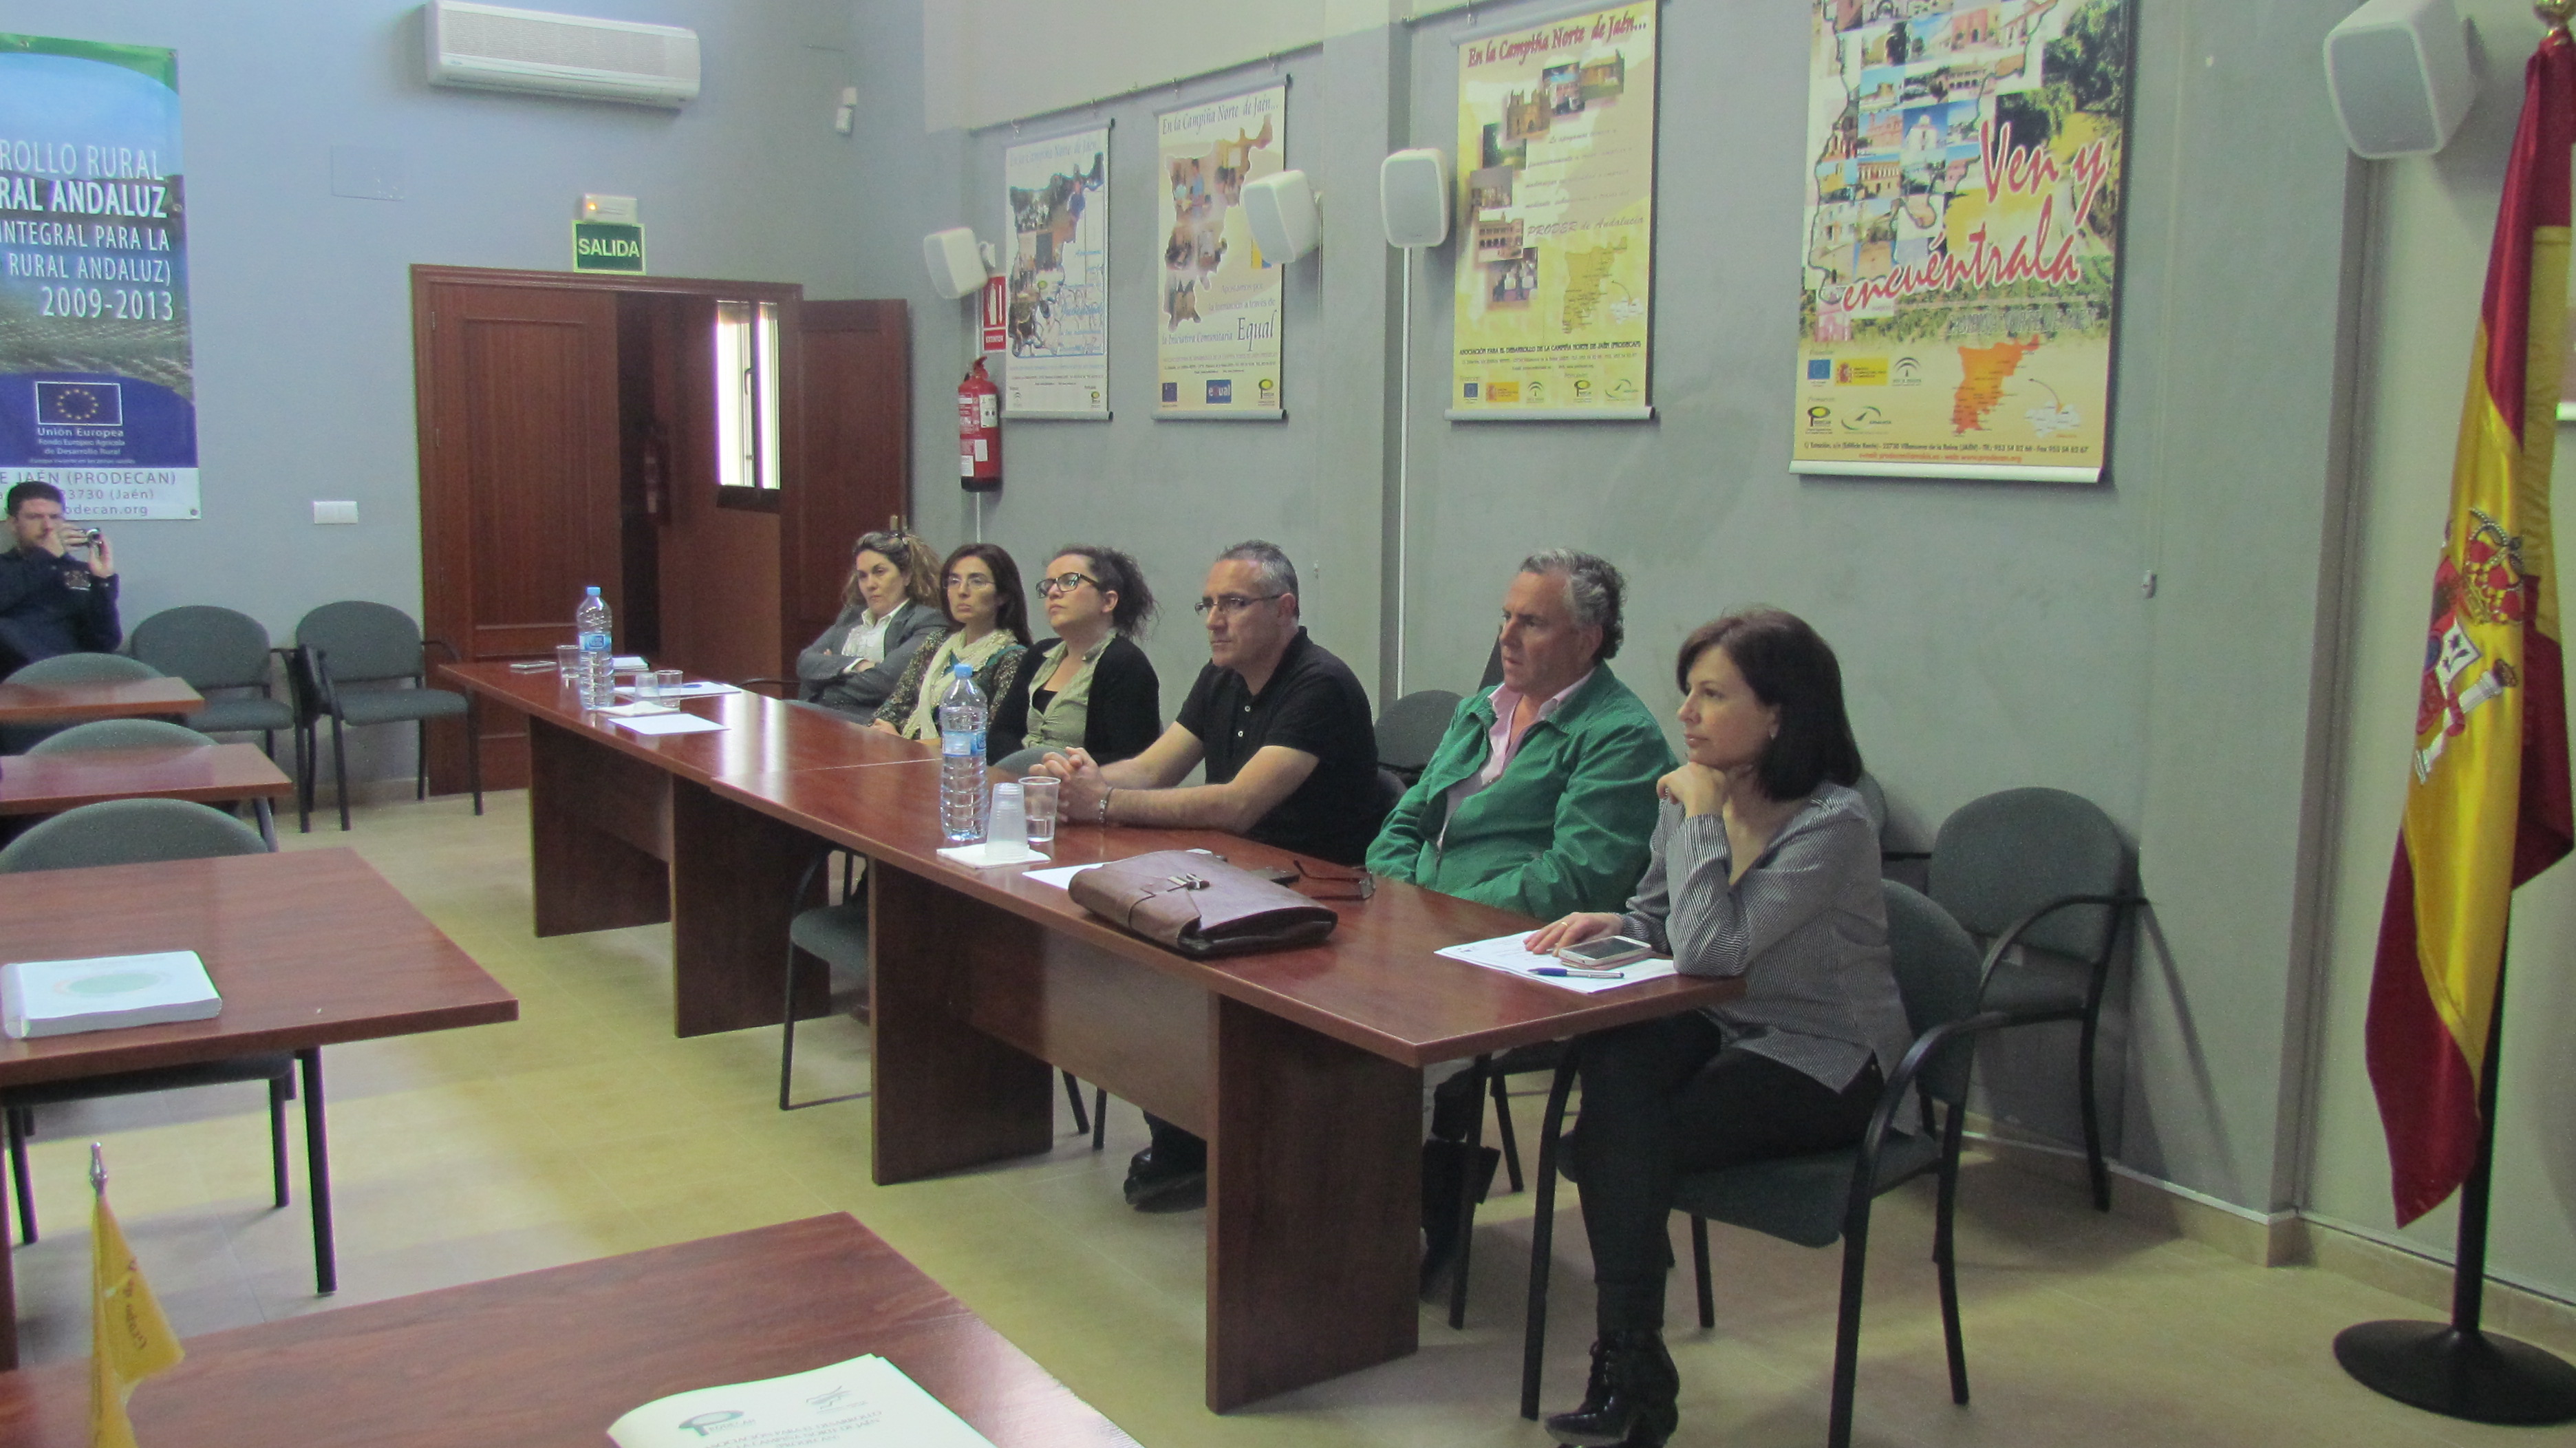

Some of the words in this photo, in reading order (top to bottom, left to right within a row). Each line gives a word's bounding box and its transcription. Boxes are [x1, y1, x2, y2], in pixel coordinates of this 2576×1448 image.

[1218, 105, 1238, 122] Norte
[87, 145, 164, 182] RURAL
[1979, 120, 2061, 204] Ven
[2070, 138, 2108, 228] y
[51, 180, 168, 219] ANDALUZ
[96, 225, 142, 251] PARA
[148, 228, 171, 252] LA
[1527, 220, 1578, 237] PRODER
[578, 238, 640, 258] SALIDA
[1840, 193, 2083, 312] encuéntrala
[9, 253, 69, 279] RURAL
[78, 256, 171, 287] ANDALUZ)
[41, 286, 174, 321] 2009-2013
[1237, 310, 1278, 352] Equal
[37, 427, 72, 437] Unión
[76, 427, 125, 438] Europea
[67, 471, 176, 486] (PRODECAN)
[110, 489, 154, 501] (Jaén)
